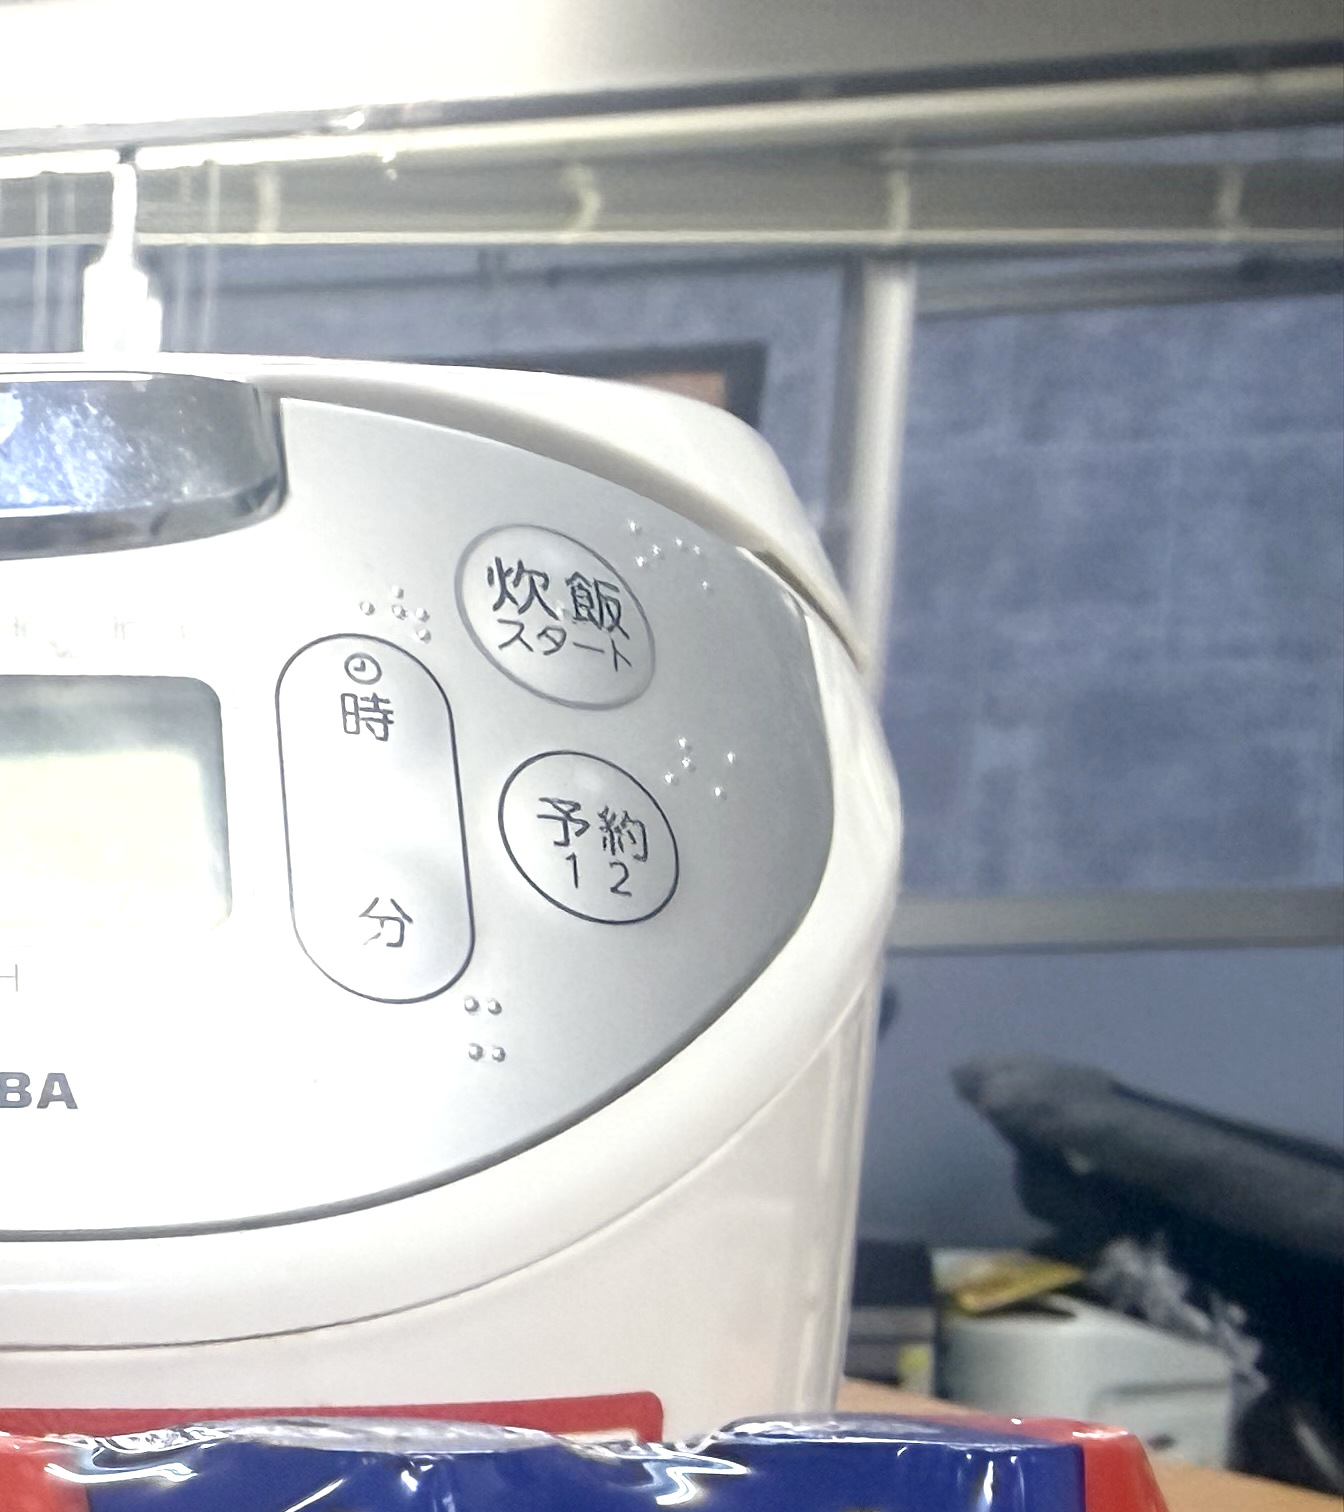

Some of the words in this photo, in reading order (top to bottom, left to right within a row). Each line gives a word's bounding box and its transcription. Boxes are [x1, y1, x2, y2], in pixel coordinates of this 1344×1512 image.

[487, 557, 630, 640] 炊飯
[498, 618, 631, 671] スタート
[341, 693, 394, 742] 時
[536, 797, 649, 862] 予約
[359, 897, 413, 948] 分
